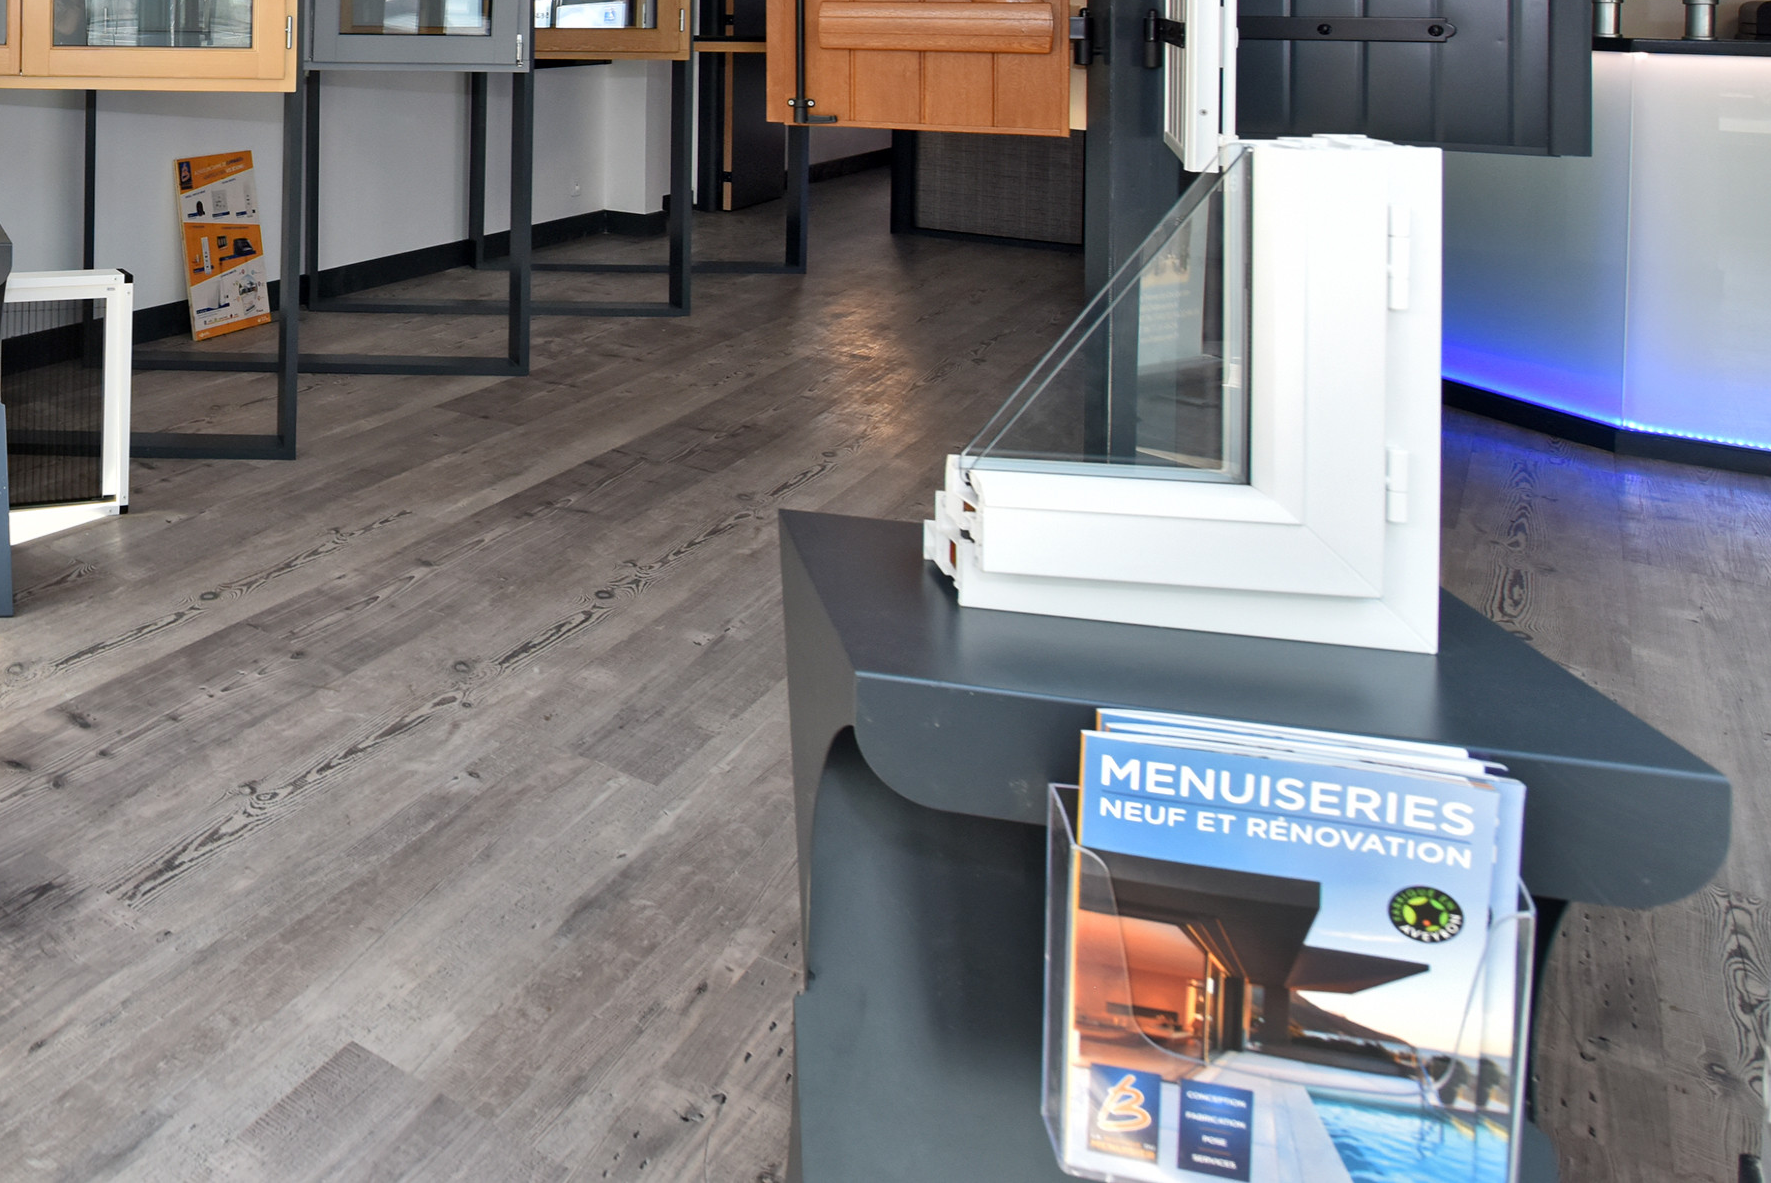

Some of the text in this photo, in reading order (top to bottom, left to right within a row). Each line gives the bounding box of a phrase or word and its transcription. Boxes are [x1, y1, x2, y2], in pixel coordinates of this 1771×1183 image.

[1099, 795, 1473, 870] NEUF ET RÉNOVATION
[1100, 753, 1475, 837] MENUISERIES
[1398, 913, 1462, 943] AVEYRON
